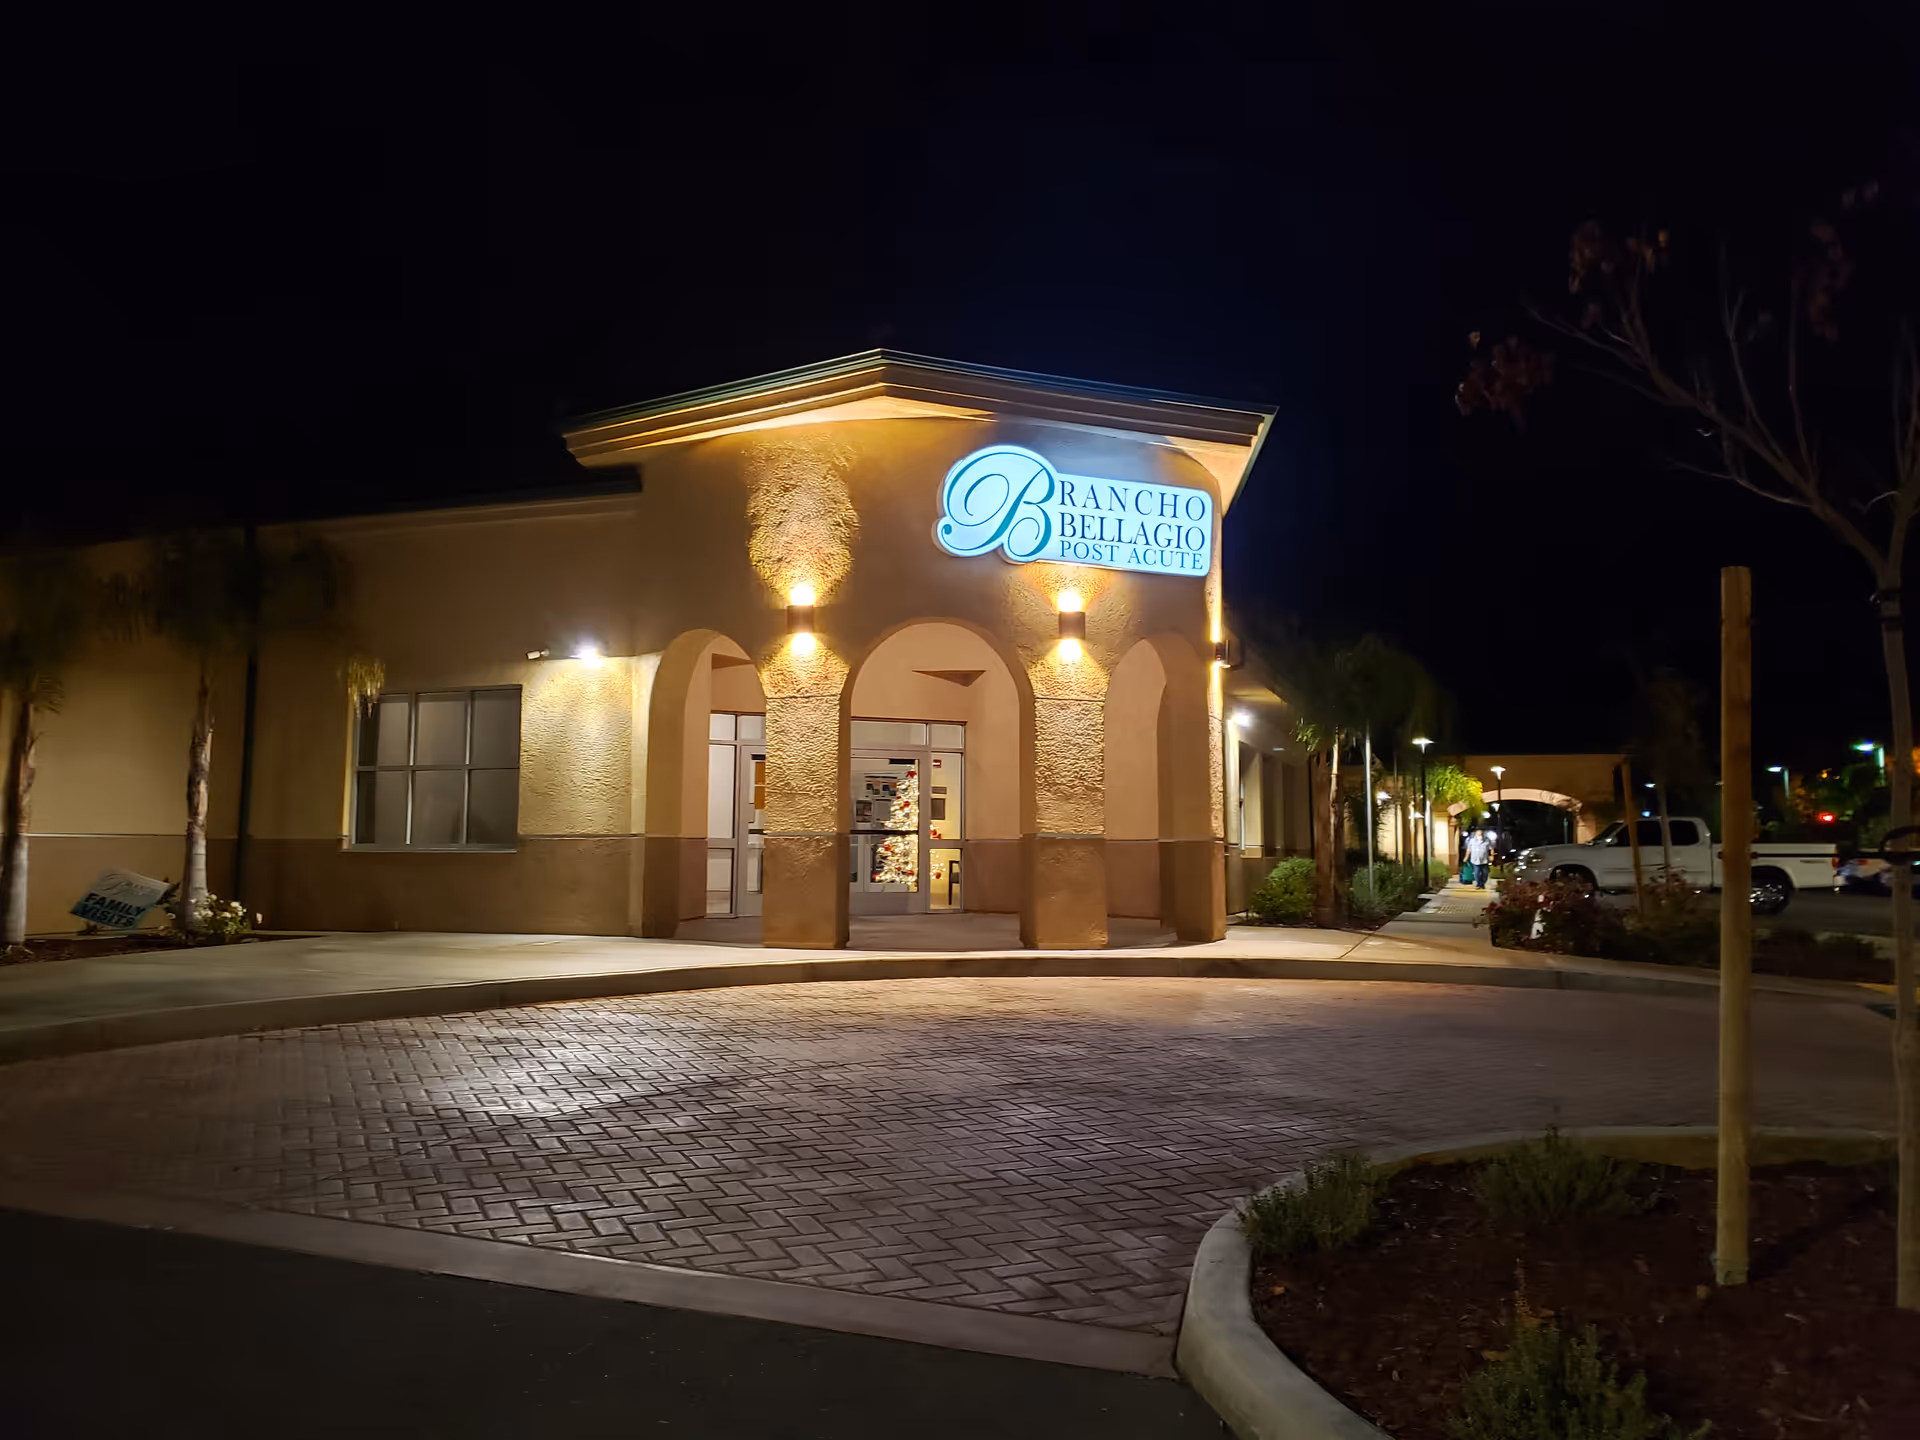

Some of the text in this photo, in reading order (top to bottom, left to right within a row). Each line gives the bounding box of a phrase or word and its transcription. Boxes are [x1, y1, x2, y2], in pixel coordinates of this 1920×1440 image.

[1058, 480, 1205, 521] RANCHO
[1058, 512, 1205, 551] BELLAGIO
[1060, 540, 1203, 570] POST ACUTE
[81, 904, 136, 927] VISITS
[85, 892, 146, 917] FAMILY
